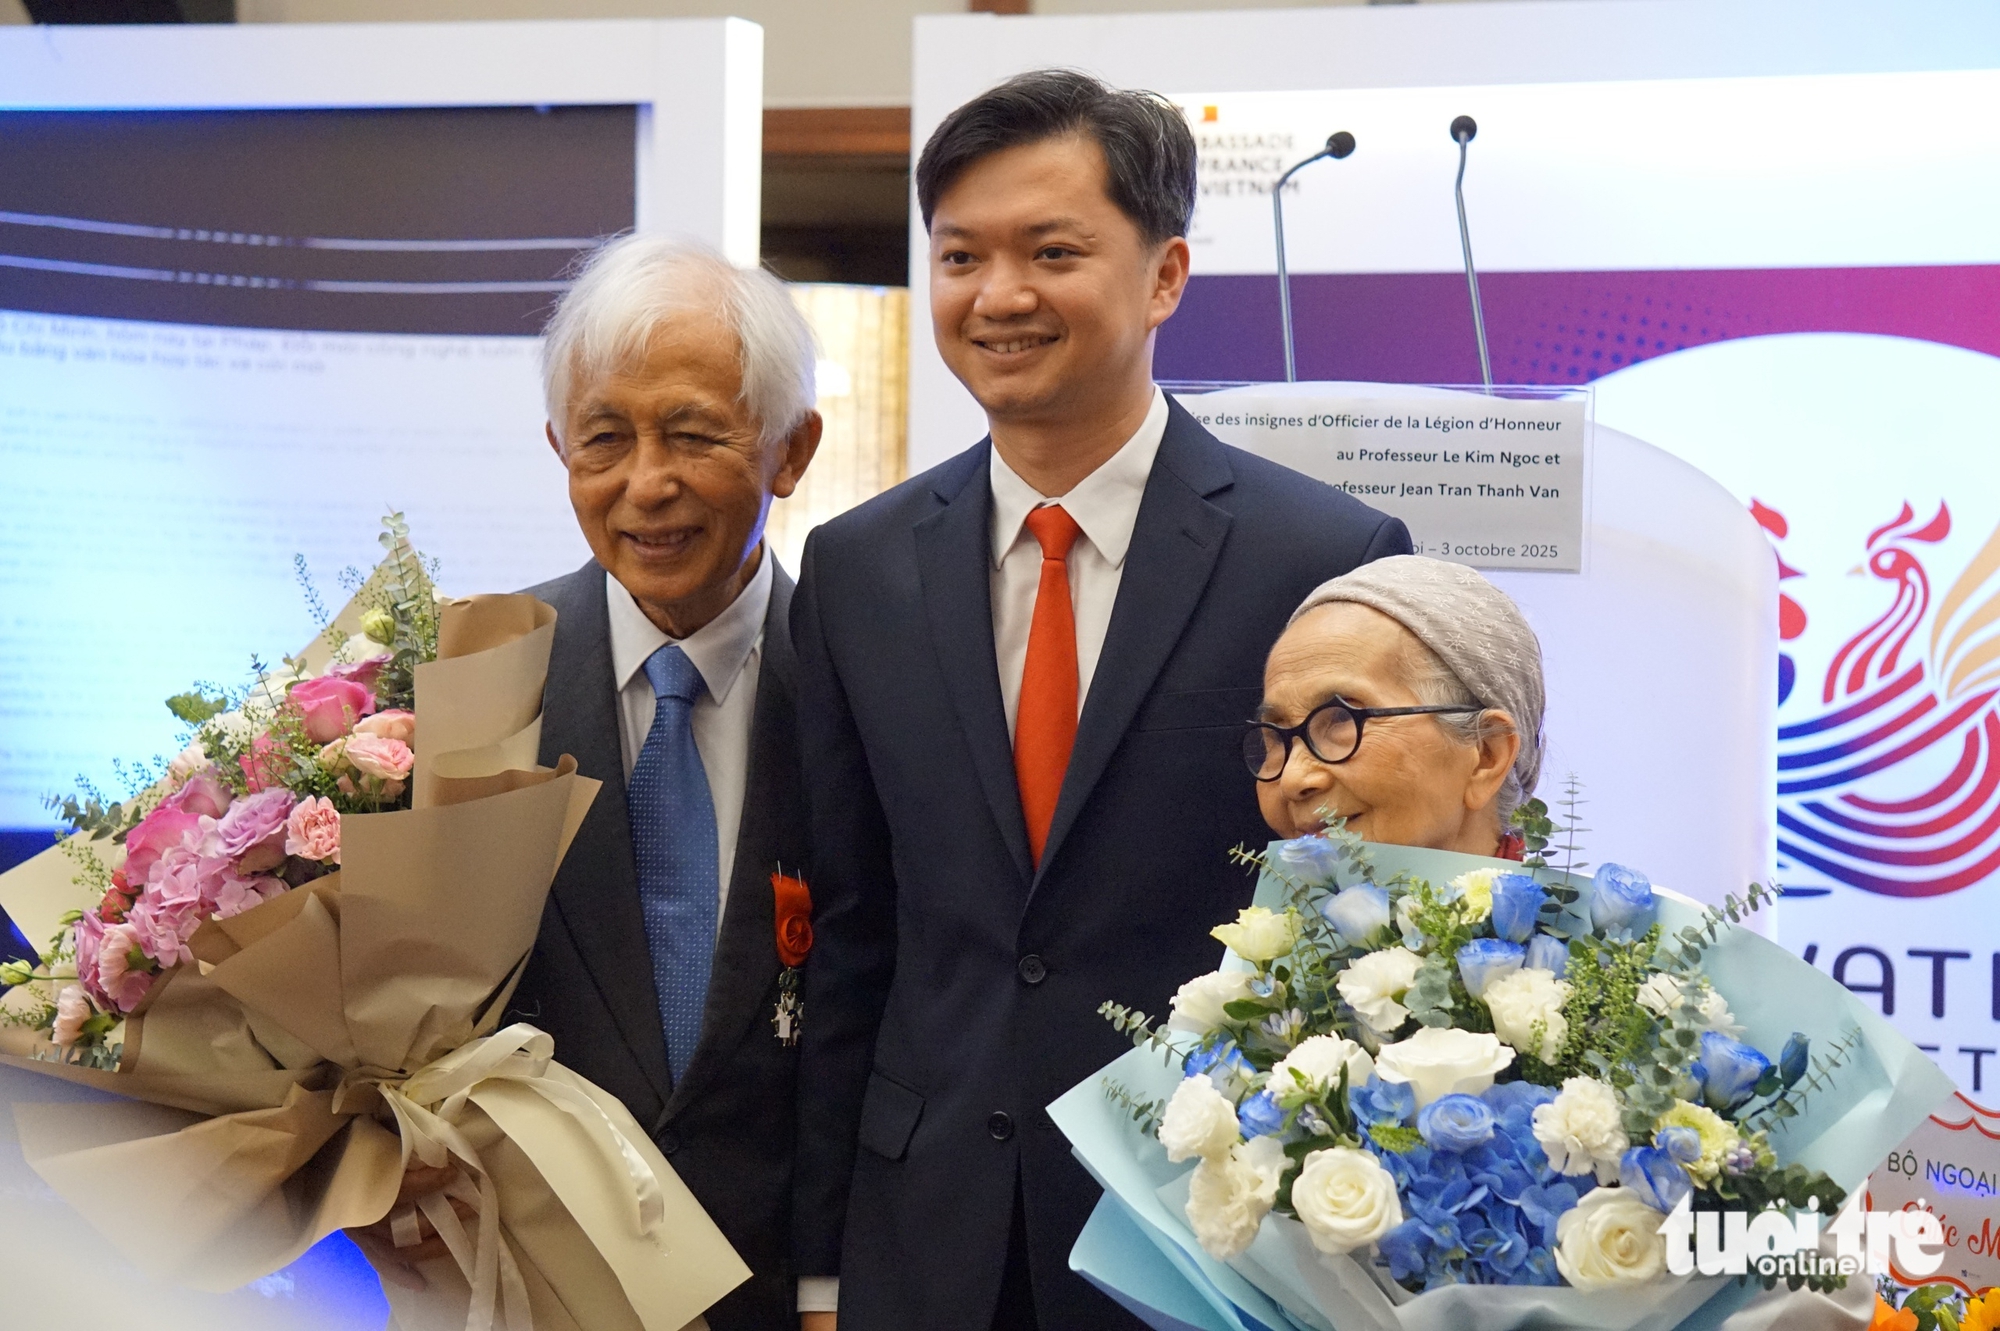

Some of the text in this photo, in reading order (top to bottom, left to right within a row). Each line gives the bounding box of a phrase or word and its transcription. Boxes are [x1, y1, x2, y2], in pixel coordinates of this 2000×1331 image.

[1190, 411, 1212, 426] se
[1214, 412, 1241, 426] des
[1245, 412, 1304, 431] insignes
[1383, 415, 1403, 429] de
[1407, 415, 1420, 429] la
[1425, 415, 1475, 434] Légion
[1336, 448, 1561, 469] au Professeur Le Kim Ngoc et
[1324, 480, 1560, 499] ofesseur Jean Tran Thanh Van
[1441, 541, 1450, 556] 3
[1454, 542, 1516, 557] octobre
[1520, 544, 1558, 559] 2025
[1887, 1149, 1996, 1197] BỘ NGOẠI
